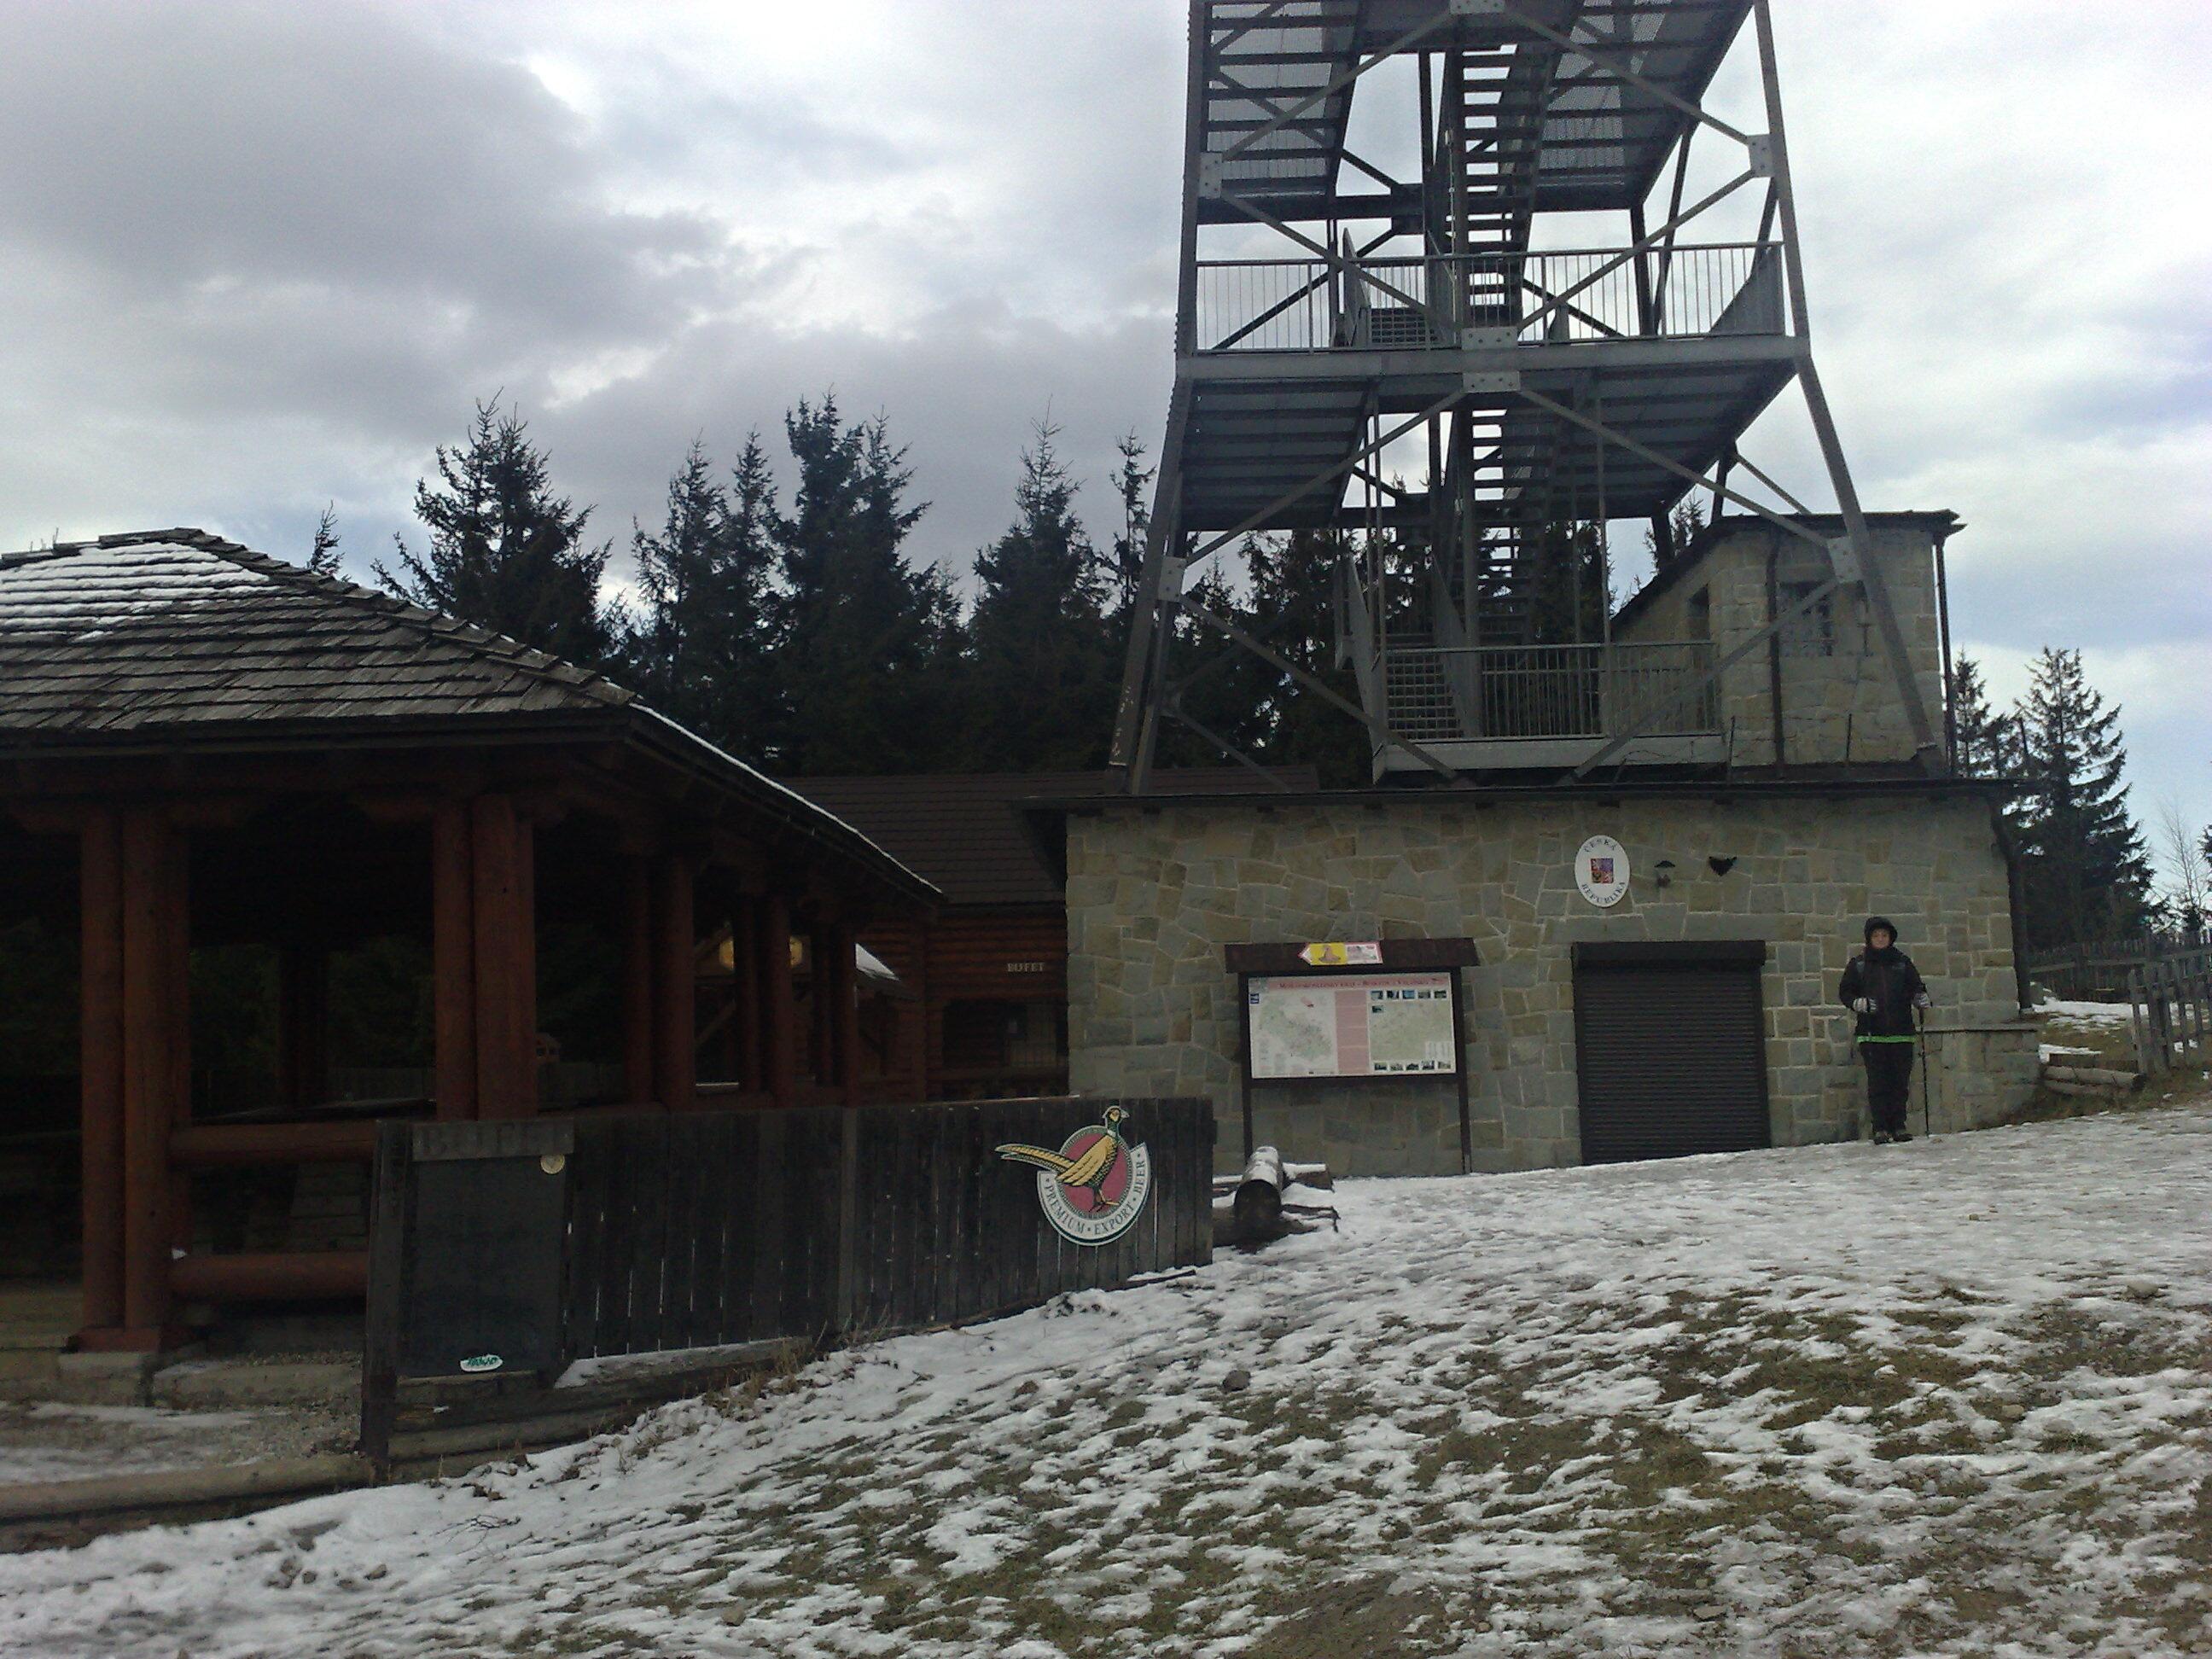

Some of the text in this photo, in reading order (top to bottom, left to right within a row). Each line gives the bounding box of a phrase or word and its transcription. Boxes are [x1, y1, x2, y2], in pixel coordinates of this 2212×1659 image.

[1044, 1159, 1146, 1235] PREMIUM EXPORT BEER
